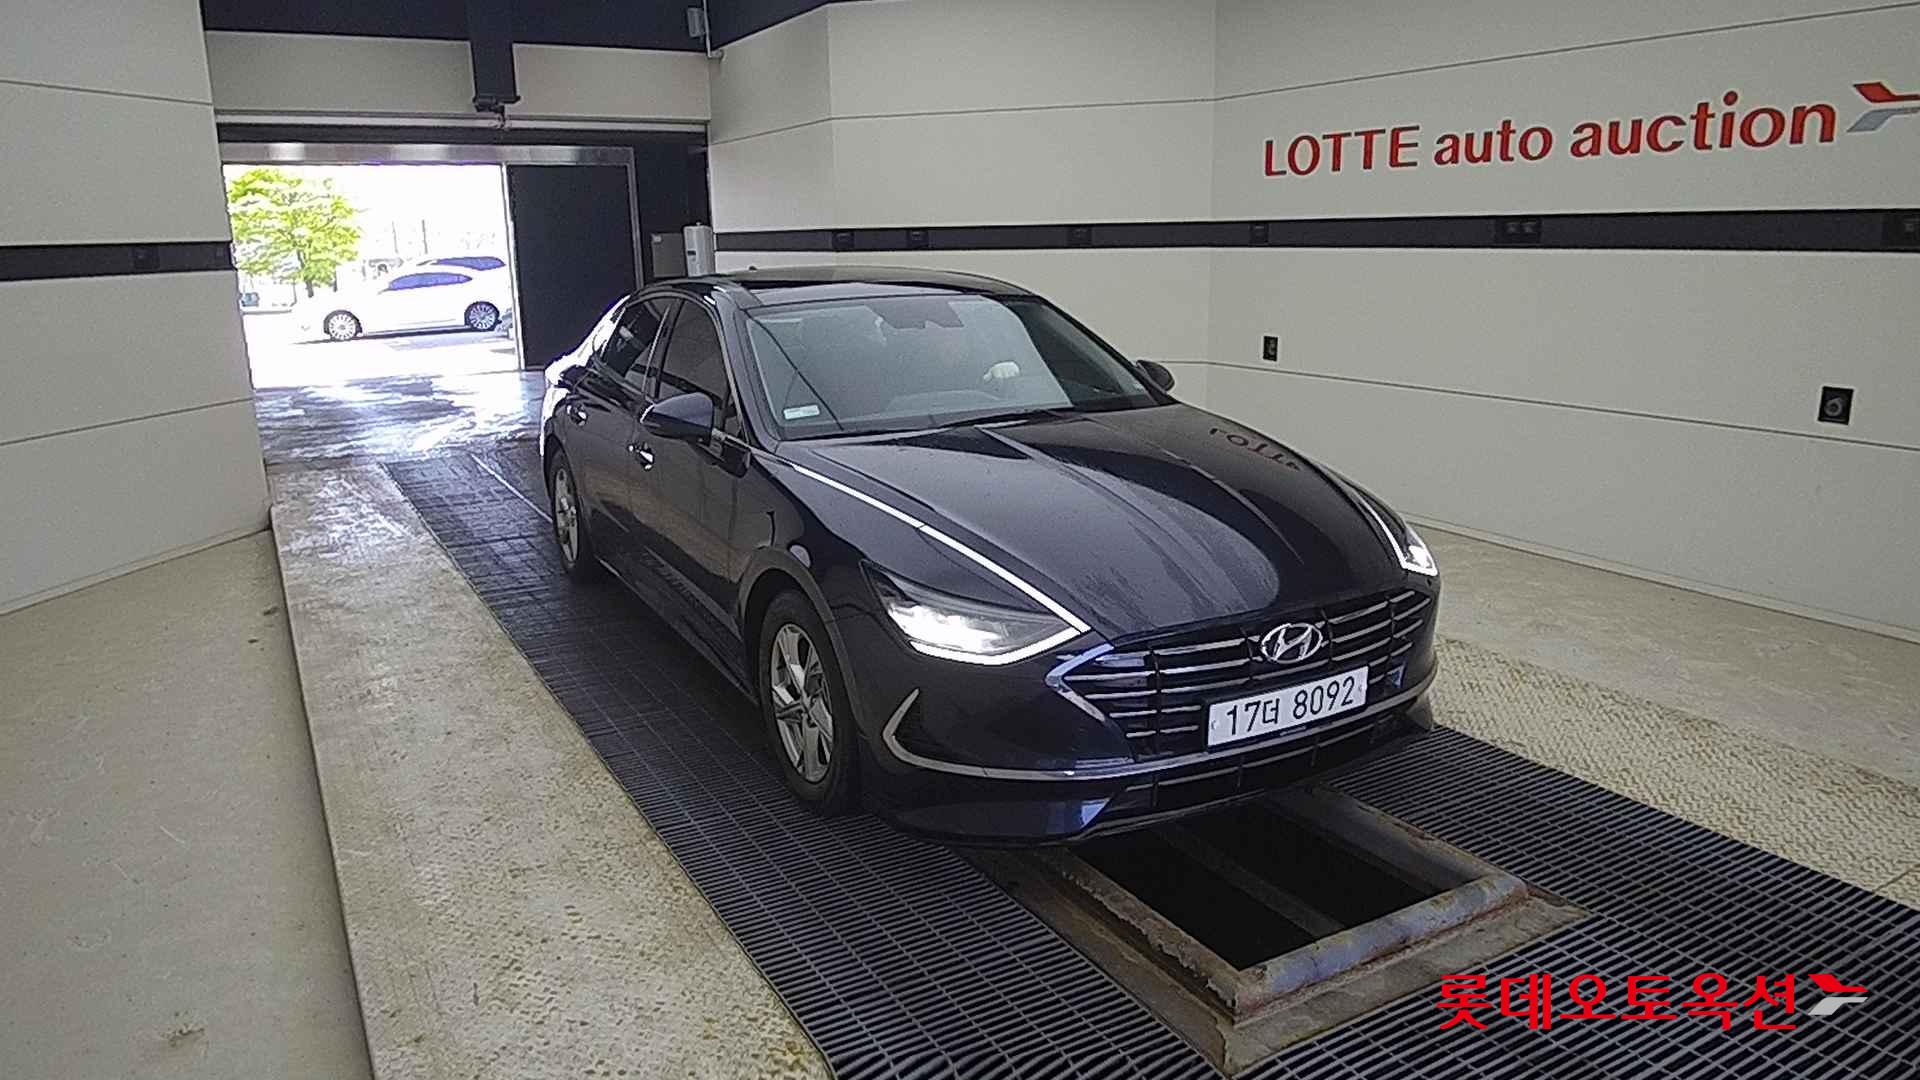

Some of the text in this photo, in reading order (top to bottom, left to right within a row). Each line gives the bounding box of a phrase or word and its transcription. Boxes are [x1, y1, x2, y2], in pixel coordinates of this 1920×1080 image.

[1264, 91, 1836, 176] LOTTE auto auction
[1226, 676, 1355, 735] 17더 8092
